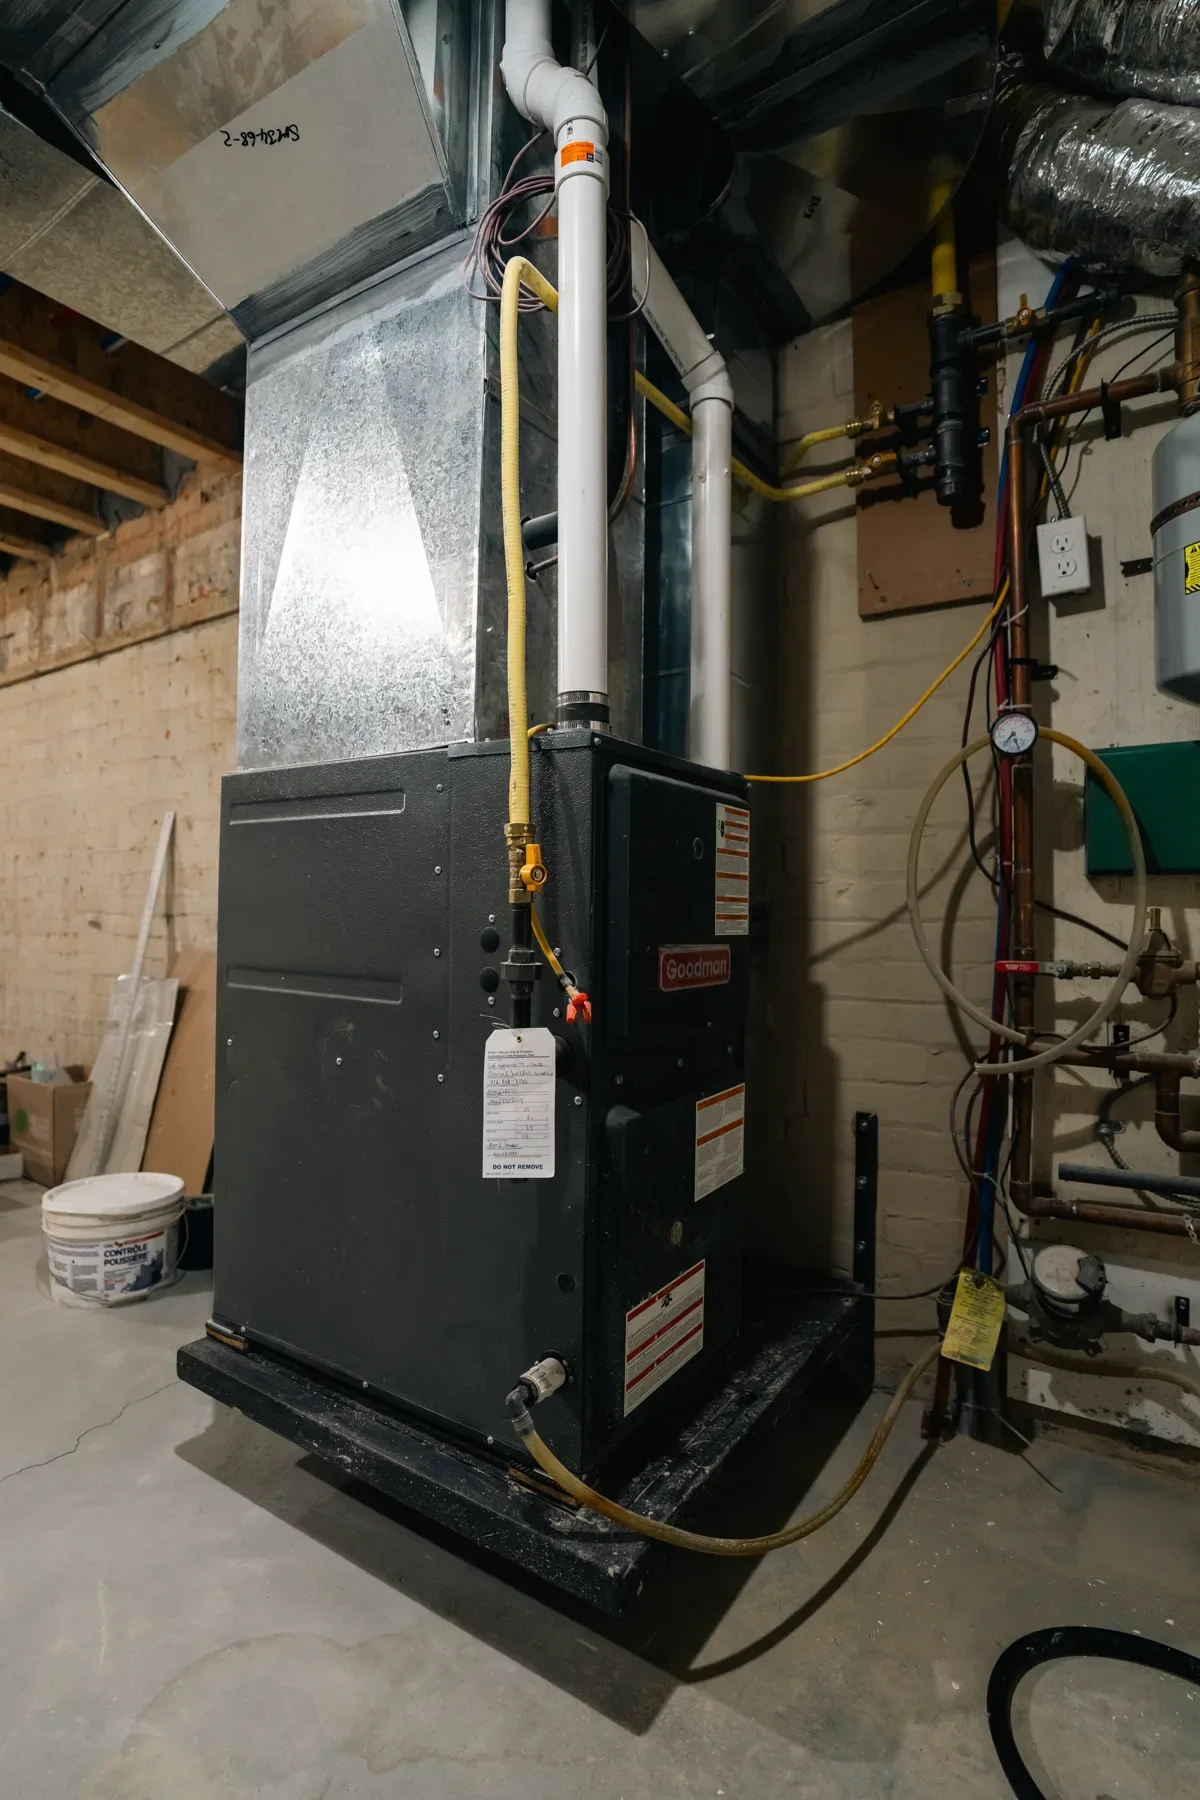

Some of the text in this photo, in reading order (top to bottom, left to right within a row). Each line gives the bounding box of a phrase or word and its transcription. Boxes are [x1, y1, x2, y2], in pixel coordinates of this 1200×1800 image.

[666, 956, 727, 981] Goodman
[104, 1243, 148, 1258] CONTRÔLE
[104, 1252, 149, 1266] POUSSIÈRE
